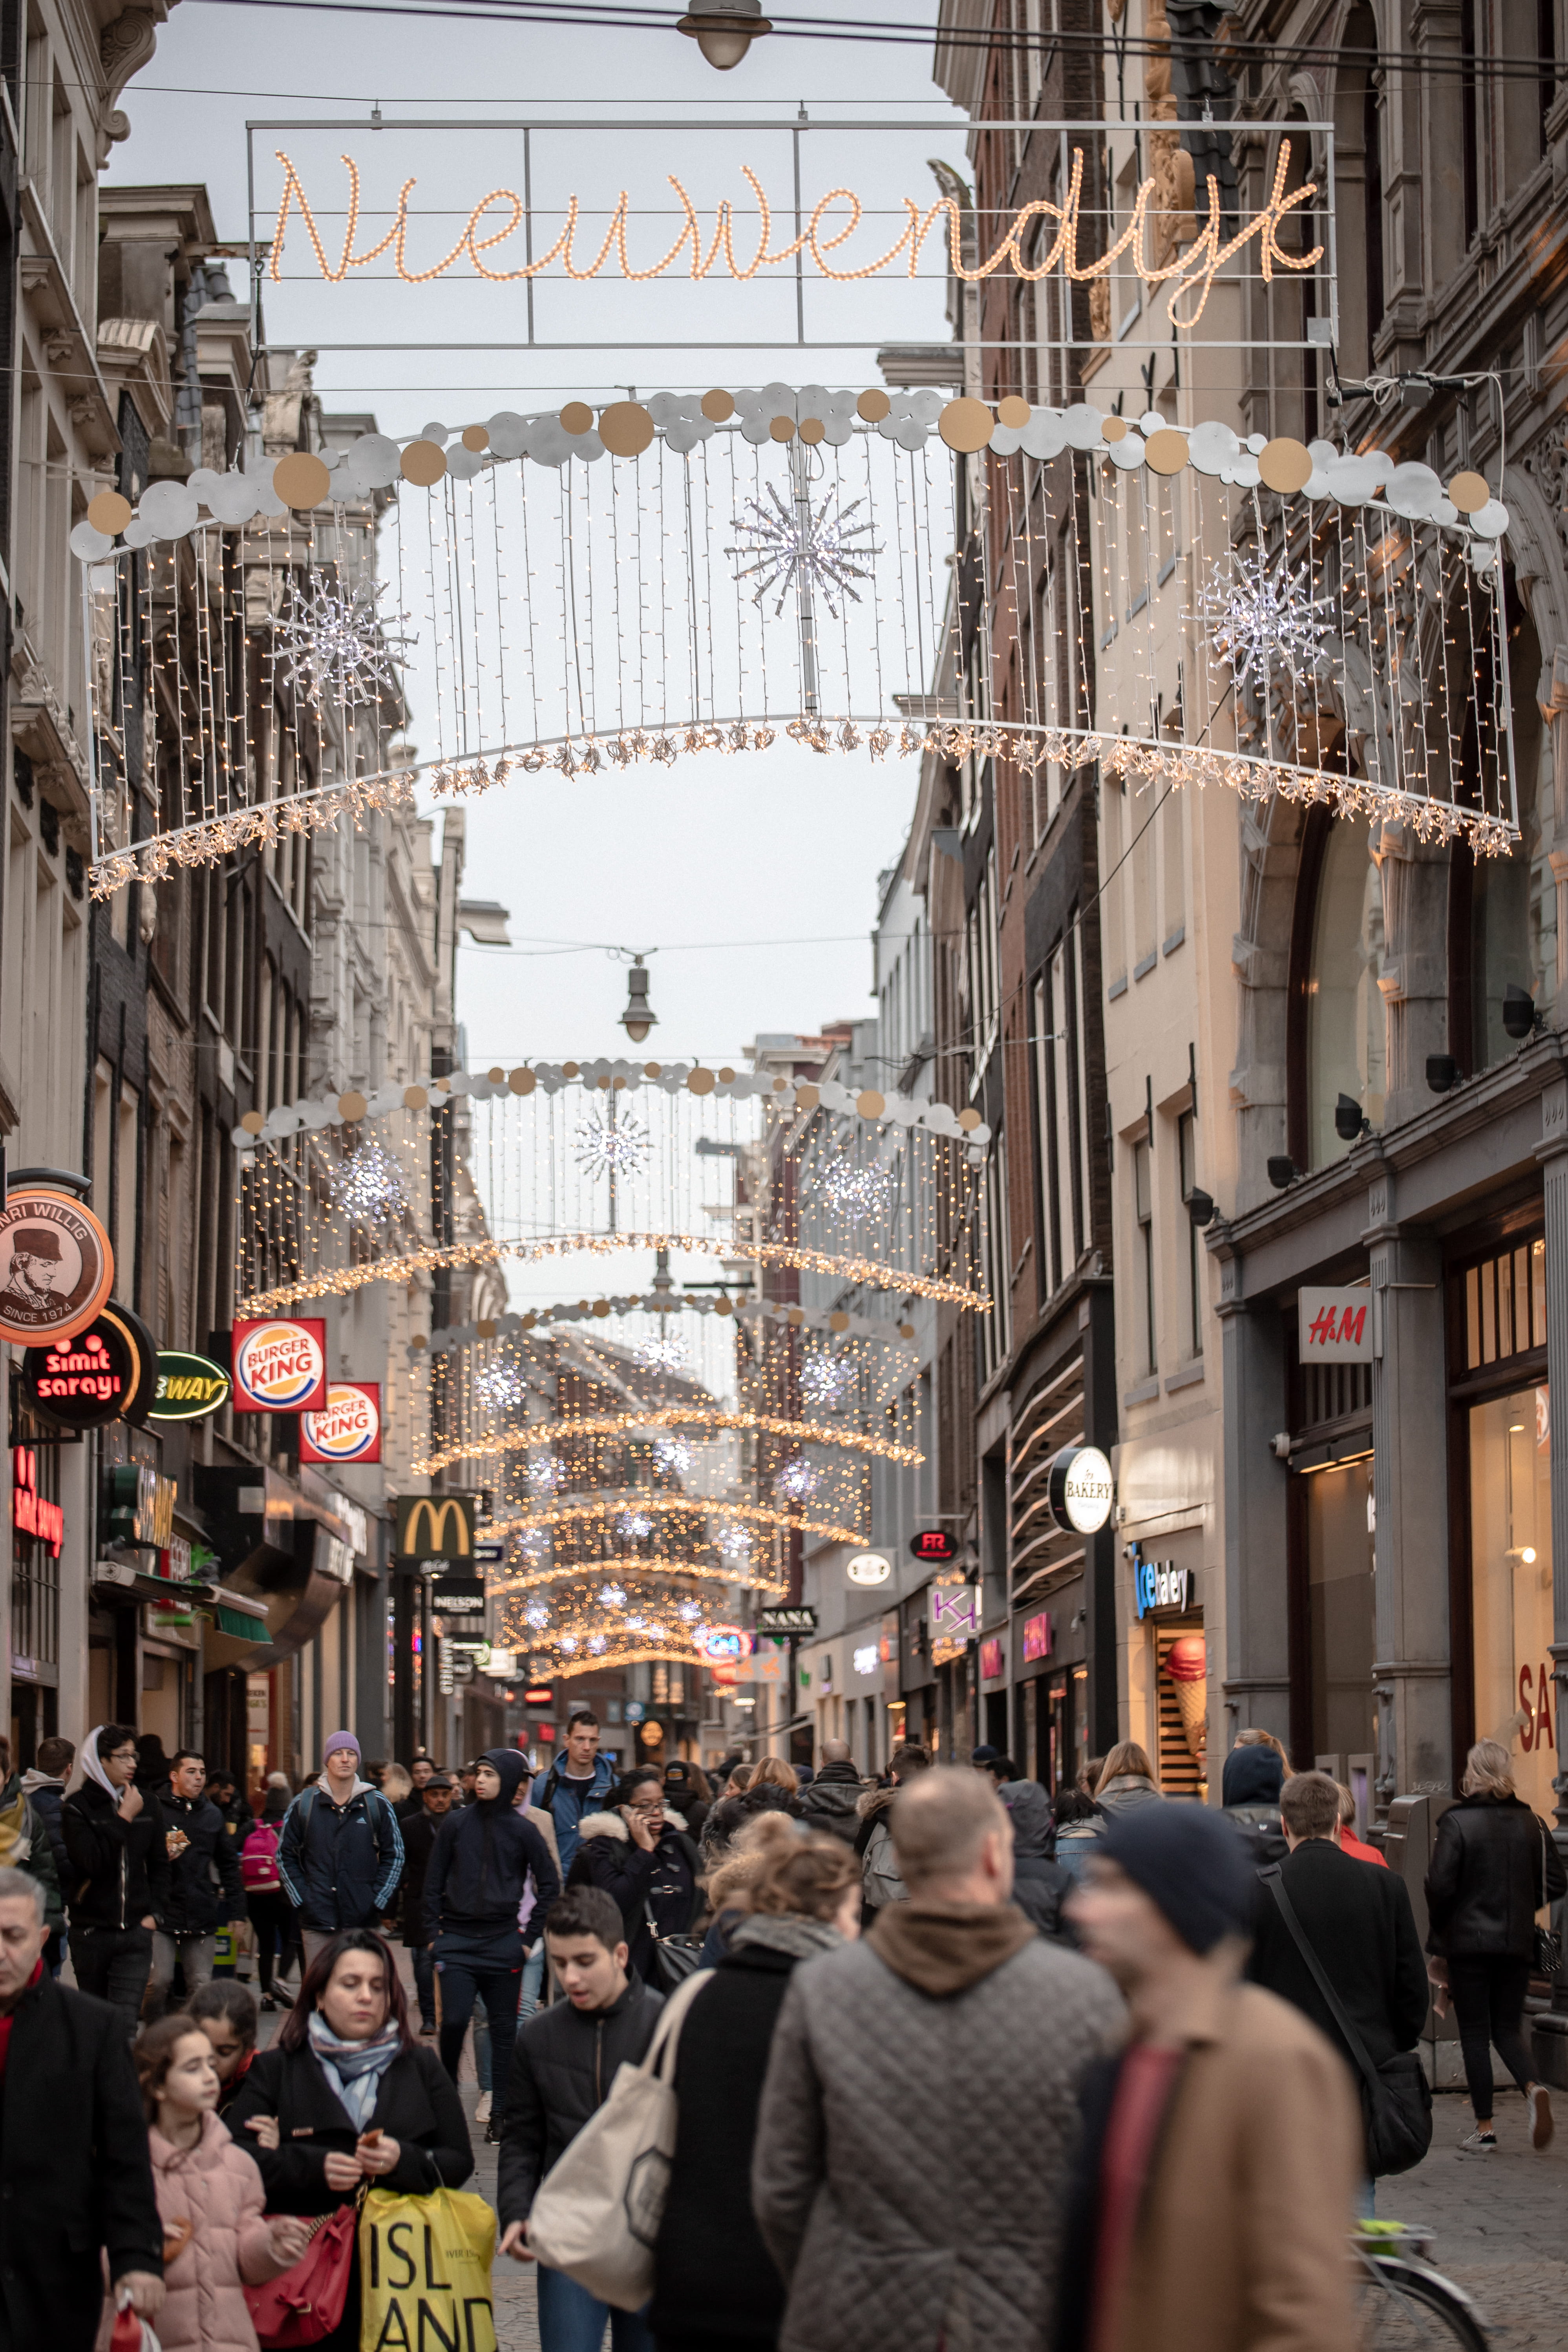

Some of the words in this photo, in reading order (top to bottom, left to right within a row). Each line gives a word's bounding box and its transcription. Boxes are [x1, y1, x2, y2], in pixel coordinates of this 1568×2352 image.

[0, 1205, 27, 1231] NRI
[34, 1203, 88, 1240] WILLIG
[4, 1305, 37, 1322] SINCE
[42, 1303, 72, 1321] 1974
[1309, 1305, 1367, 1345] H&M
[46, 1335, 110, 1372] simit
[248, 1338, 309, 1368] BURGER
[155, 1375, 229, 1400] BWAY
[250, 1353, 313, 1391] KING
[314, 1400, 366, 1424] BURGER
[316, 1413, 369, 1446] KING
[1067, 1481, 1113, 1499] BAKERY
[433, 1595, 484, 1608] NELSON
[762, 1611, 814, 1626] NANA
[1519, 1663, 1557, 1753] SA
[370, 2221, 452, 2290] ISL
